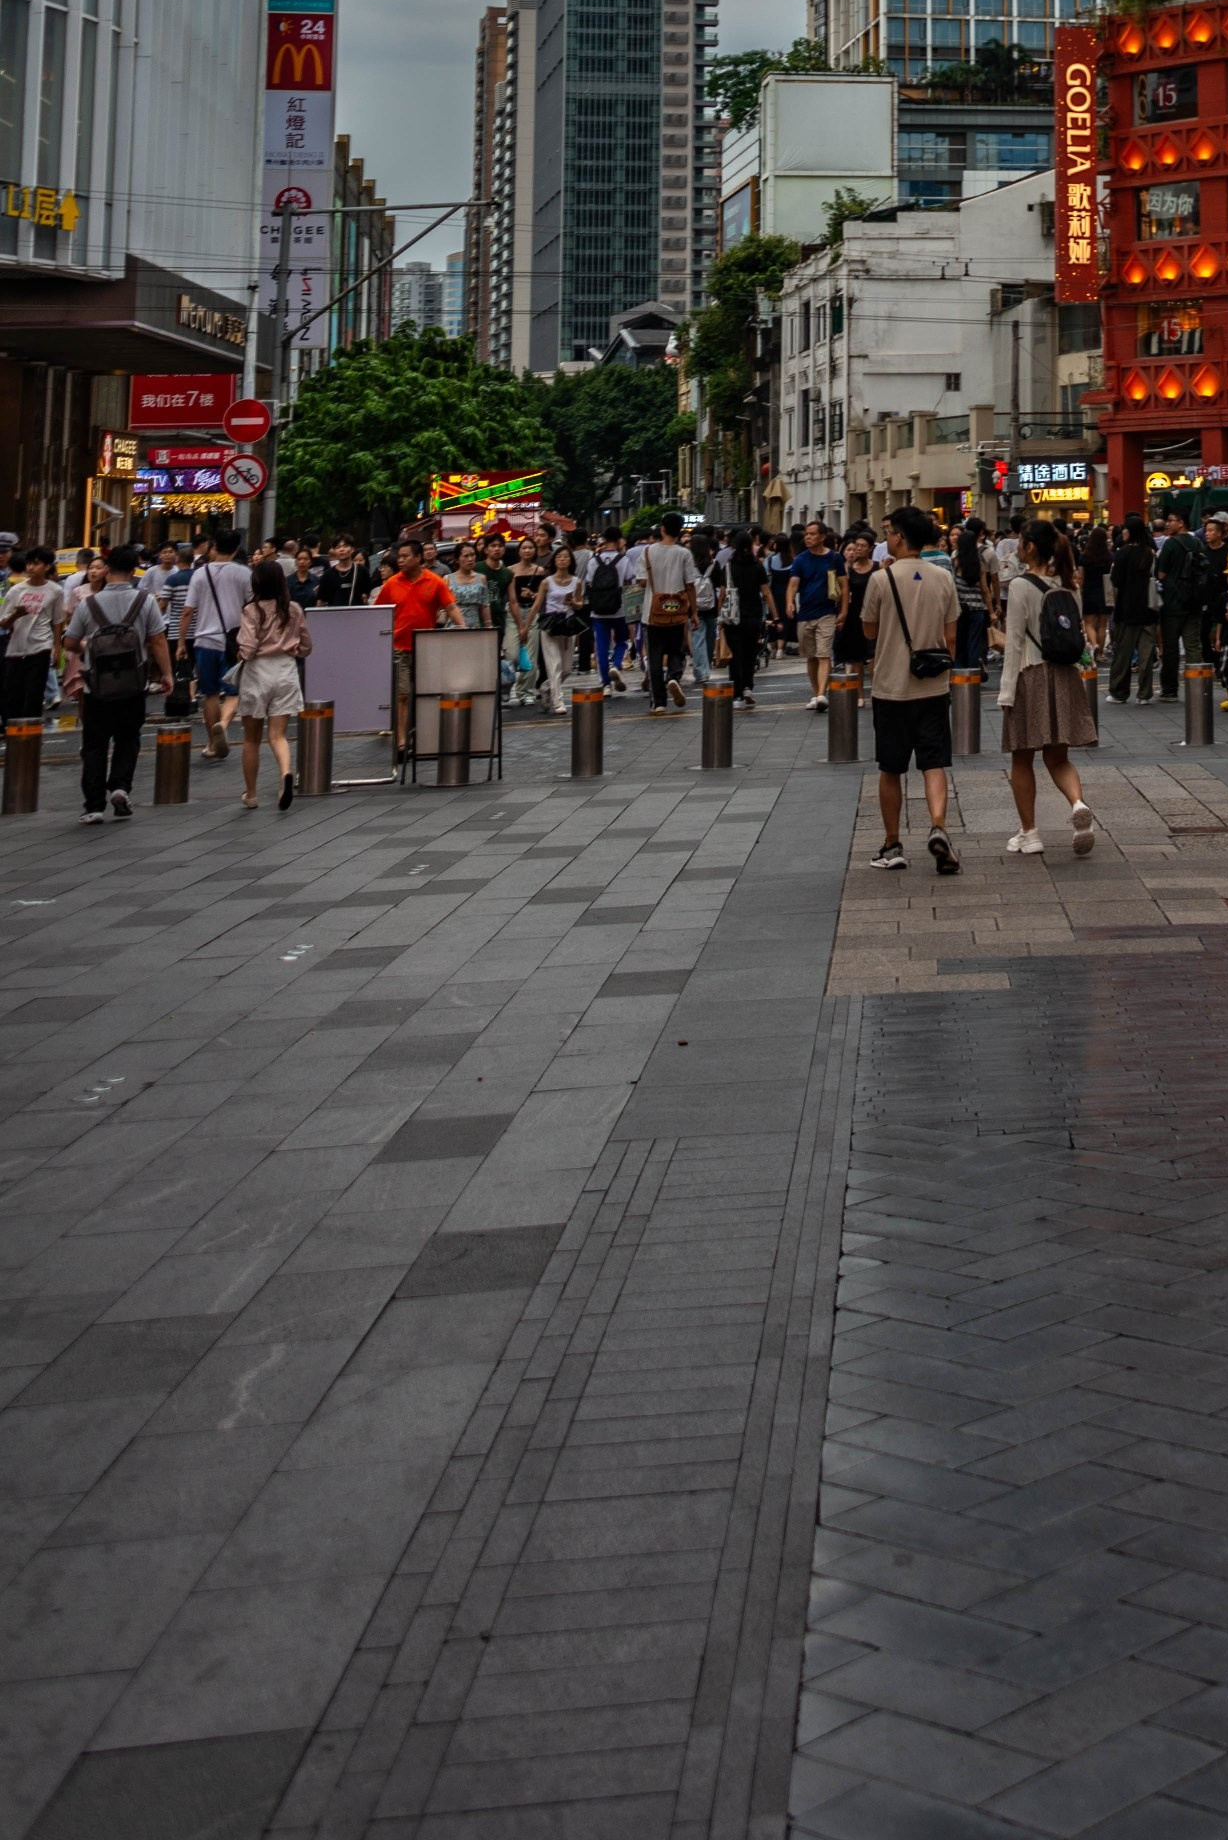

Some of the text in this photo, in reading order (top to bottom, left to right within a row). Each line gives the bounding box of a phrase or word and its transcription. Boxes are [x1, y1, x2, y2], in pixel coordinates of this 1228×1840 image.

[300, 19, 326, 34] 24
[1157, 83, 1177, 107] 15
[285, 96, 307, 149] 紅燈記
[1066, 63, 1091, 176] GOELIA
[1147, 190, 1195, 215] 因为你
[259, 225, 325, 235] CHGEE
[1067, 183, 1091, 264] 歌莉娅
[1161, 319, 1182, 341] 15
[141, 390, 215, 408] 我们在7楼
